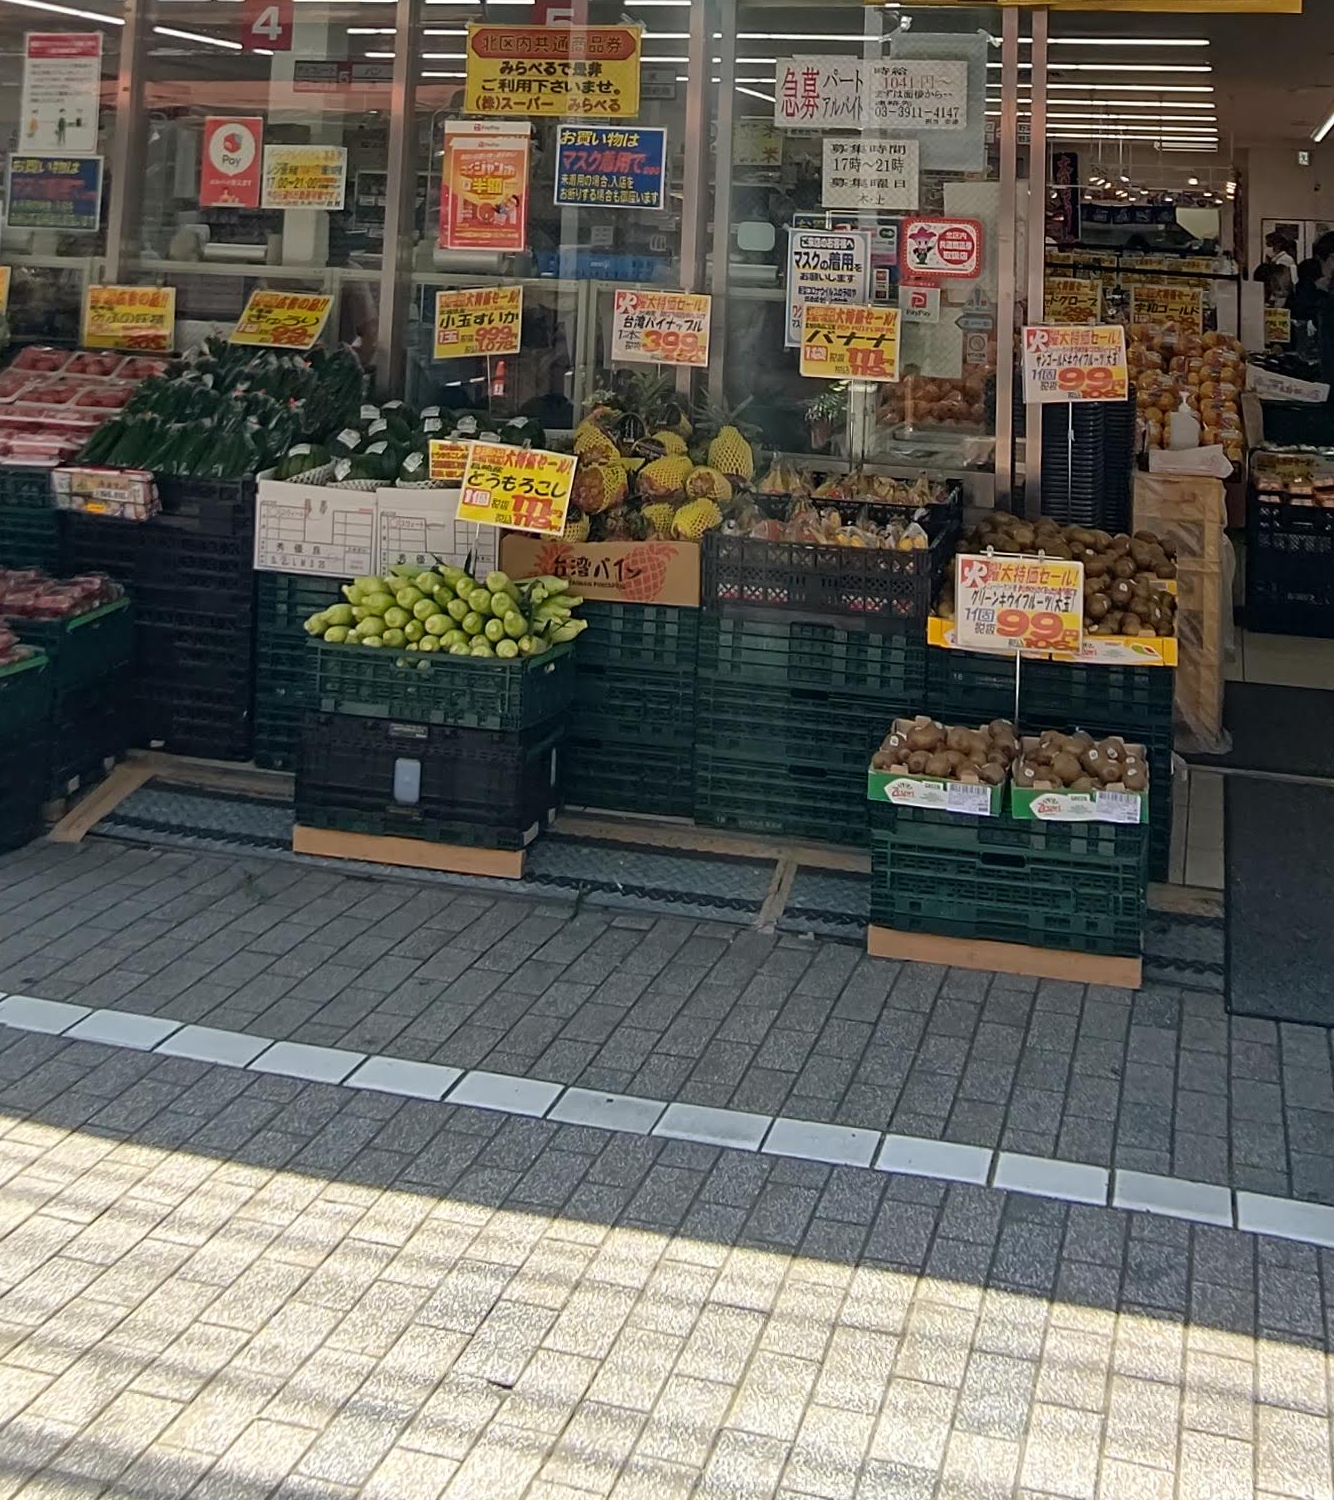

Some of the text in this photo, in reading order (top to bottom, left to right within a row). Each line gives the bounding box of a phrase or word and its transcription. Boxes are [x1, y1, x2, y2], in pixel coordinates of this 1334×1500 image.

[252, 6, 282, 40] 4
[482, 35, 621, 54] 北区内共通商品券
[481, 78, 621, 96] ご利用下さいませ。
[823, 69, 863, 93] パート
[781, 67, 820, 119] 急募
[560, 130, 640, 147] お買い物は
[222, 155, 242, 167] Pay
[794, 251, 862, 273] マスクの着用を
[805, 330, 896, 348] バナナ
[467, 471, 567, 498] とうもろこし
